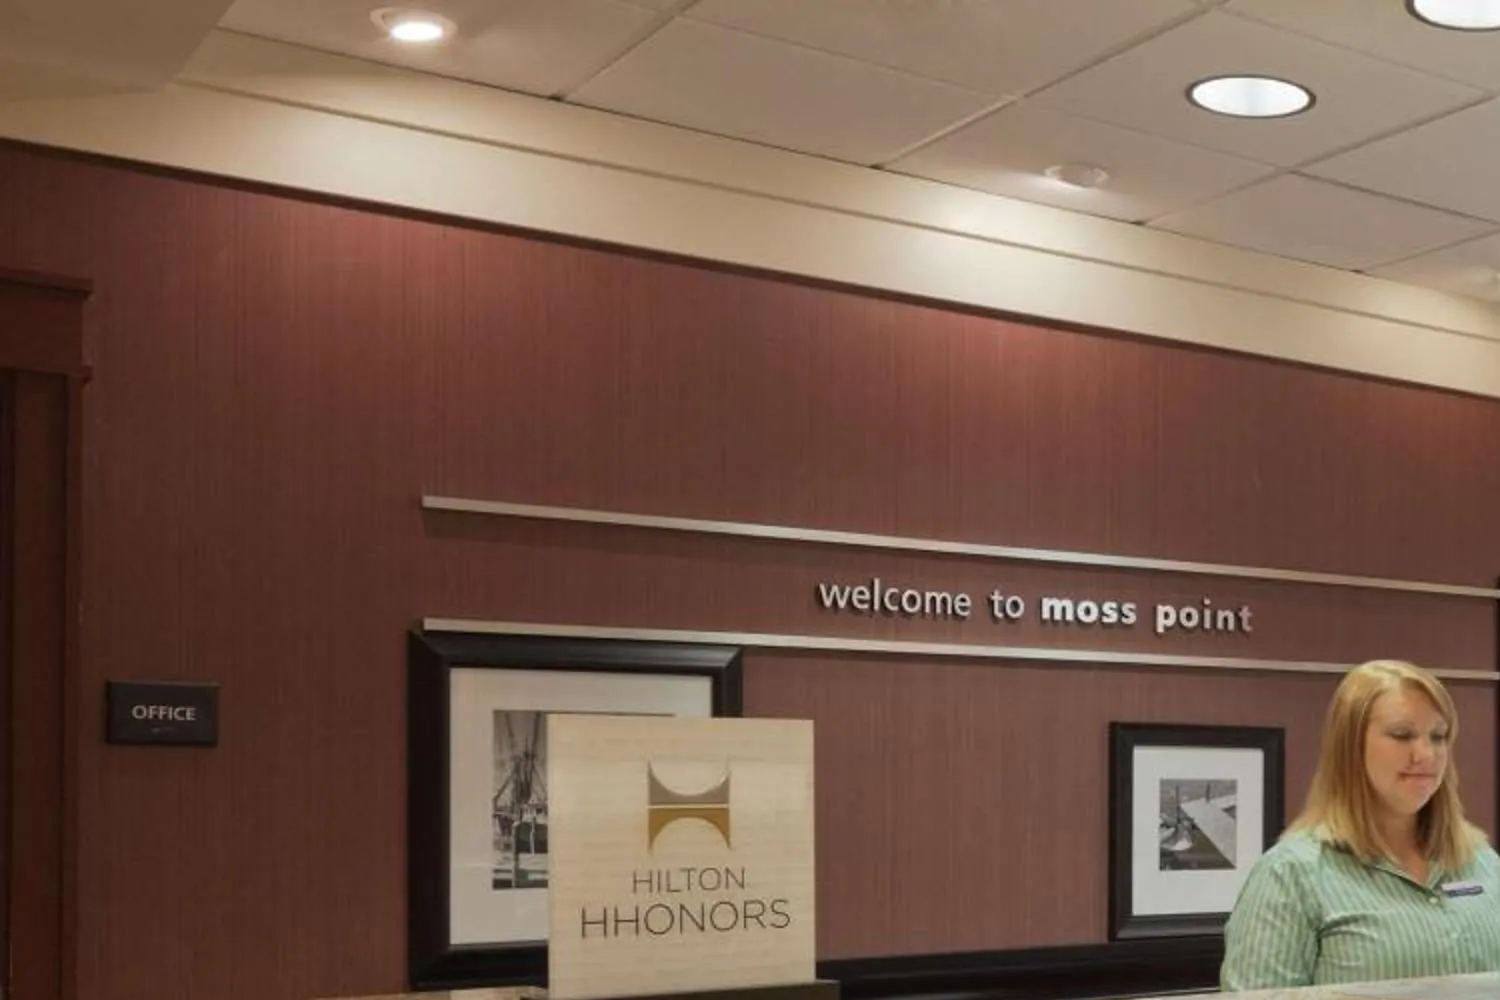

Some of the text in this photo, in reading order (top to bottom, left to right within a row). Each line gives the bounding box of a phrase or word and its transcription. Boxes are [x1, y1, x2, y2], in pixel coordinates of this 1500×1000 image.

[819, 578, 1253, 634] welcome to moss point
[131, 704, 197, 721] OFFICE
[632, 865, 746, 894] HILTON
[581, 898, 791, 939] HHONORS
